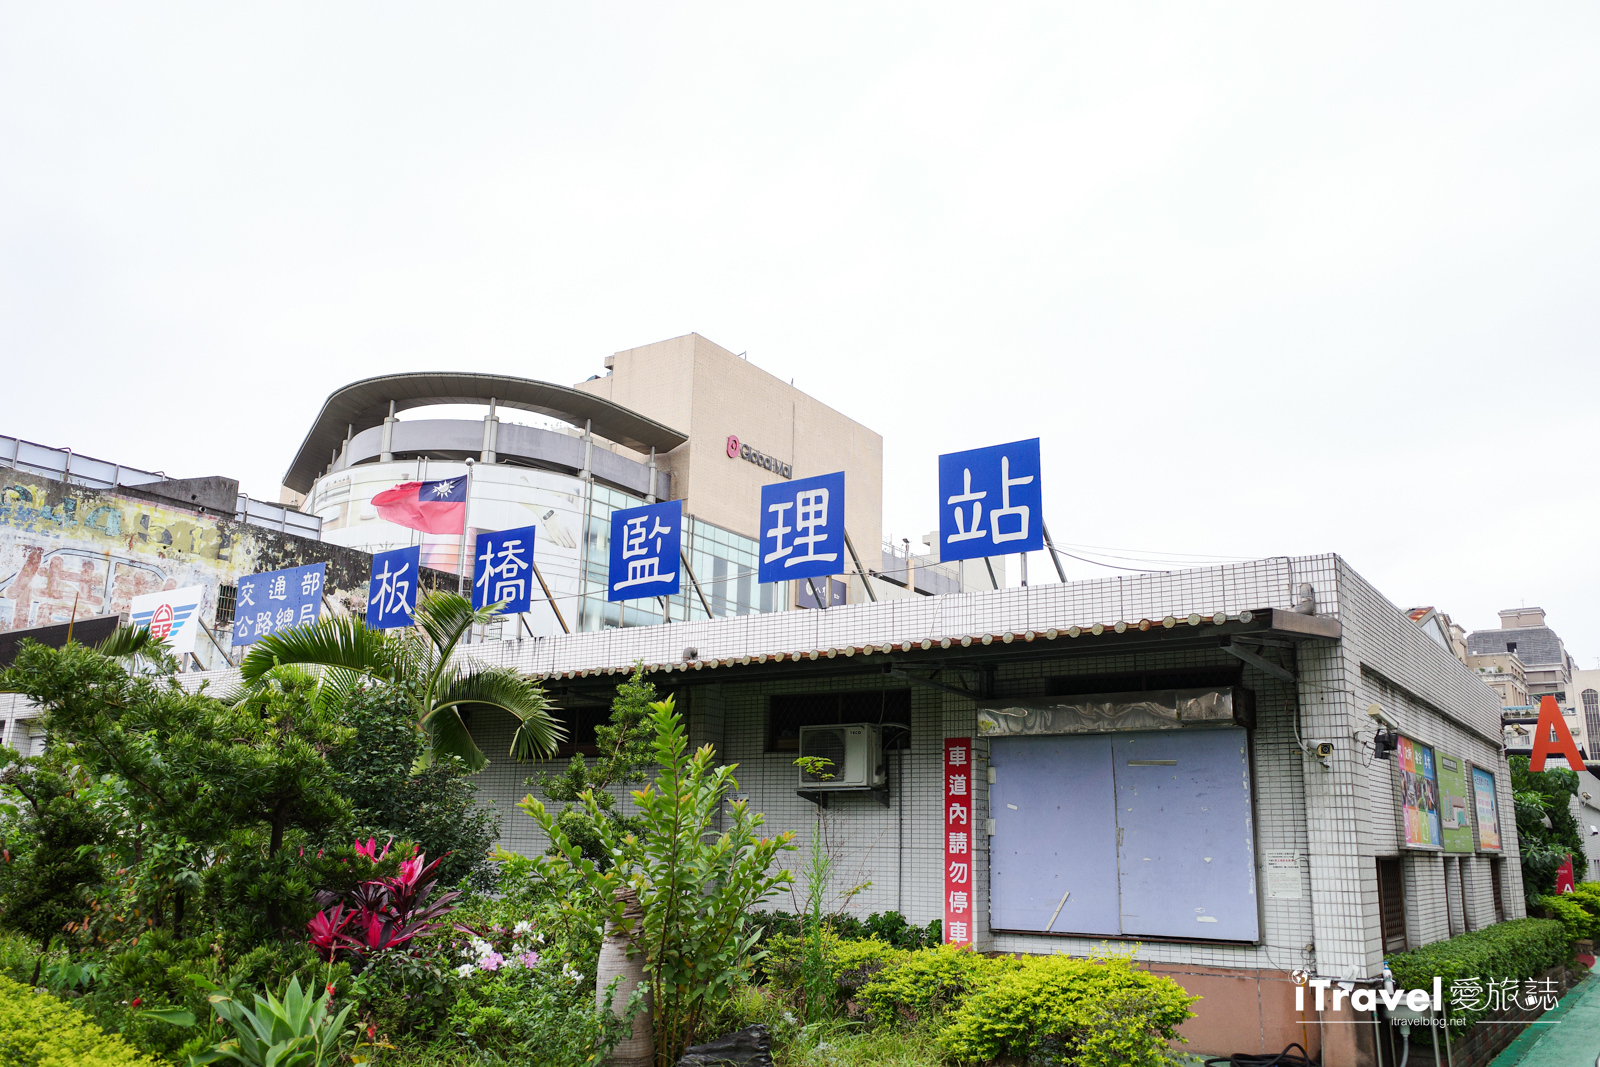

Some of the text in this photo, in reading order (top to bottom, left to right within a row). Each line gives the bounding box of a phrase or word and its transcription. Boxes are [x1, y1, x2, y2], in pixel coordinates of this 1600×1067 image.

[740, 443, 772, 471] Global
[238, 571, 320, 608] 交通部
[236, 603, 316, 638] 公路總局
[1529, 695, 1587, 772] A
[948, 745, 968, 944] 車道內請勿停車
[1564, 883, 1574, 893] A
